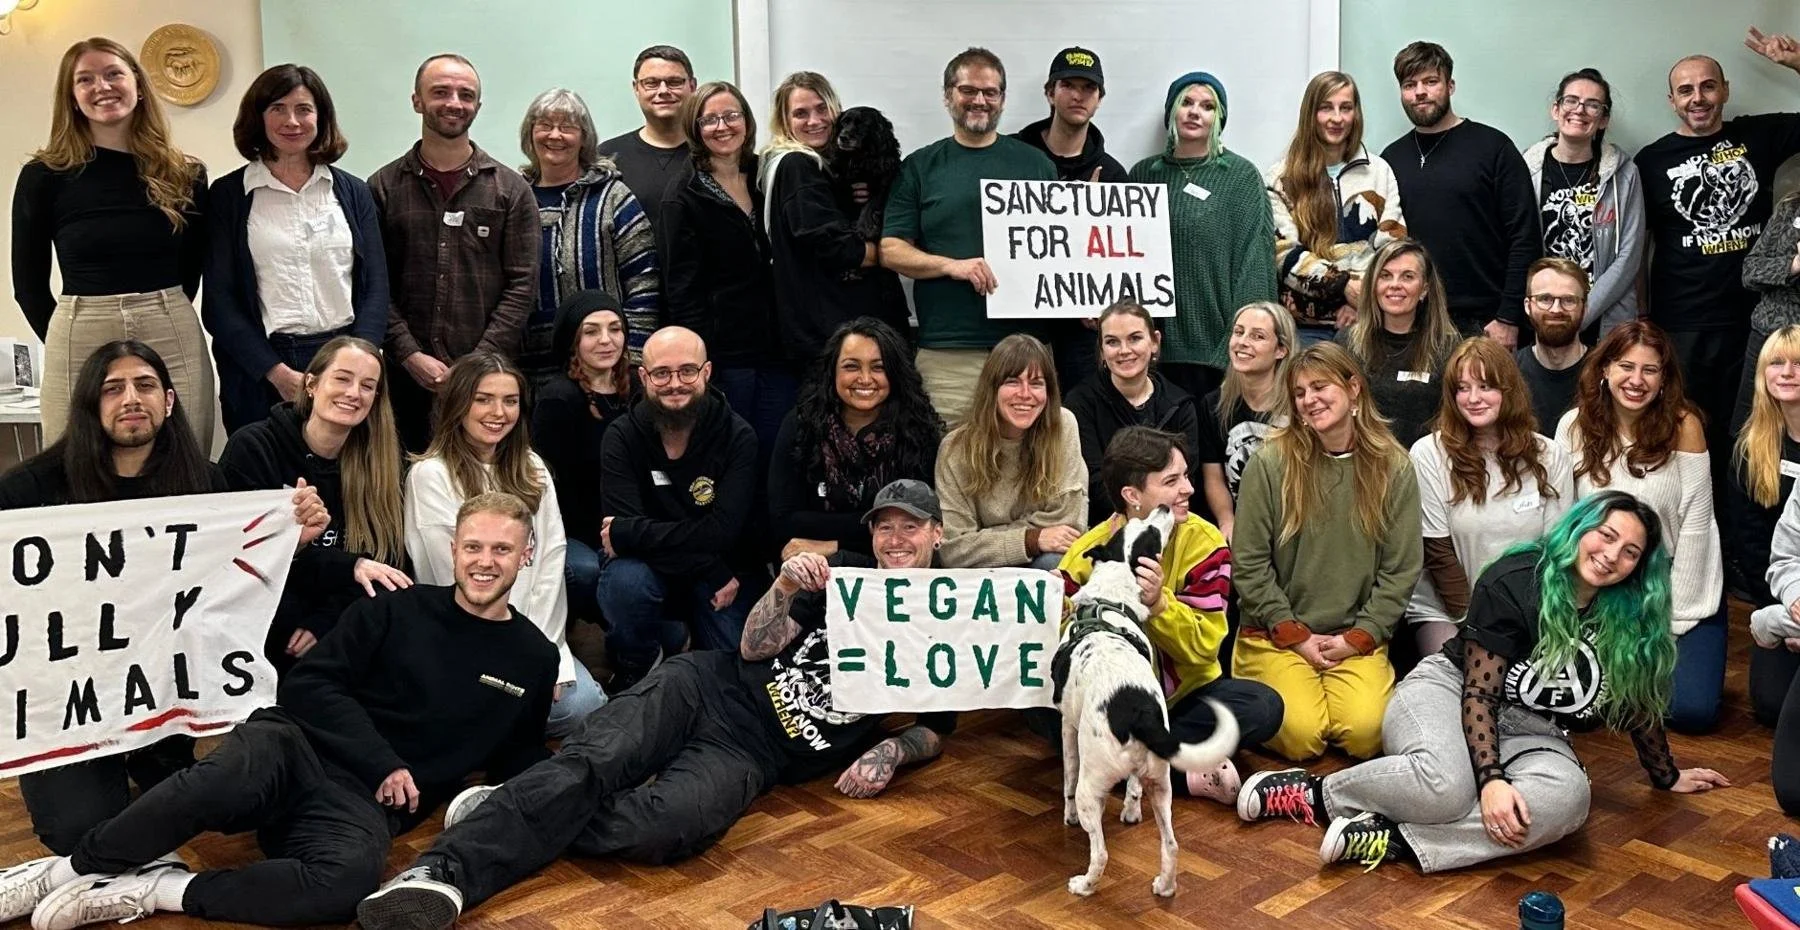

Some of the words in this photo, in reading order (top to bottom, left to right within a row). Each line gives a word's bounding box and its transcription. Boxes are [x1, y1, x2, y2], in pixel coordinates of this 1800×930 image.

[985, 182, 1160, 218] SANCTUARY
[1008, 225, 1071, 259] FOR
[1087, 225, 1145, 258] ALL
[1682, 236, 1694, 247] IF
[1696, 231, 1728, 247] NOT
[1731, 223, 1761, 241] NOW
[1702, 239, 1748, 254] WHEN?
[1034, 272, 1175, 309] ANIMALS
[835, 576, 1047, 624] VEGAN
[774, 672, 800, 712] NOT
[793, 713, 832, 751] NOW
